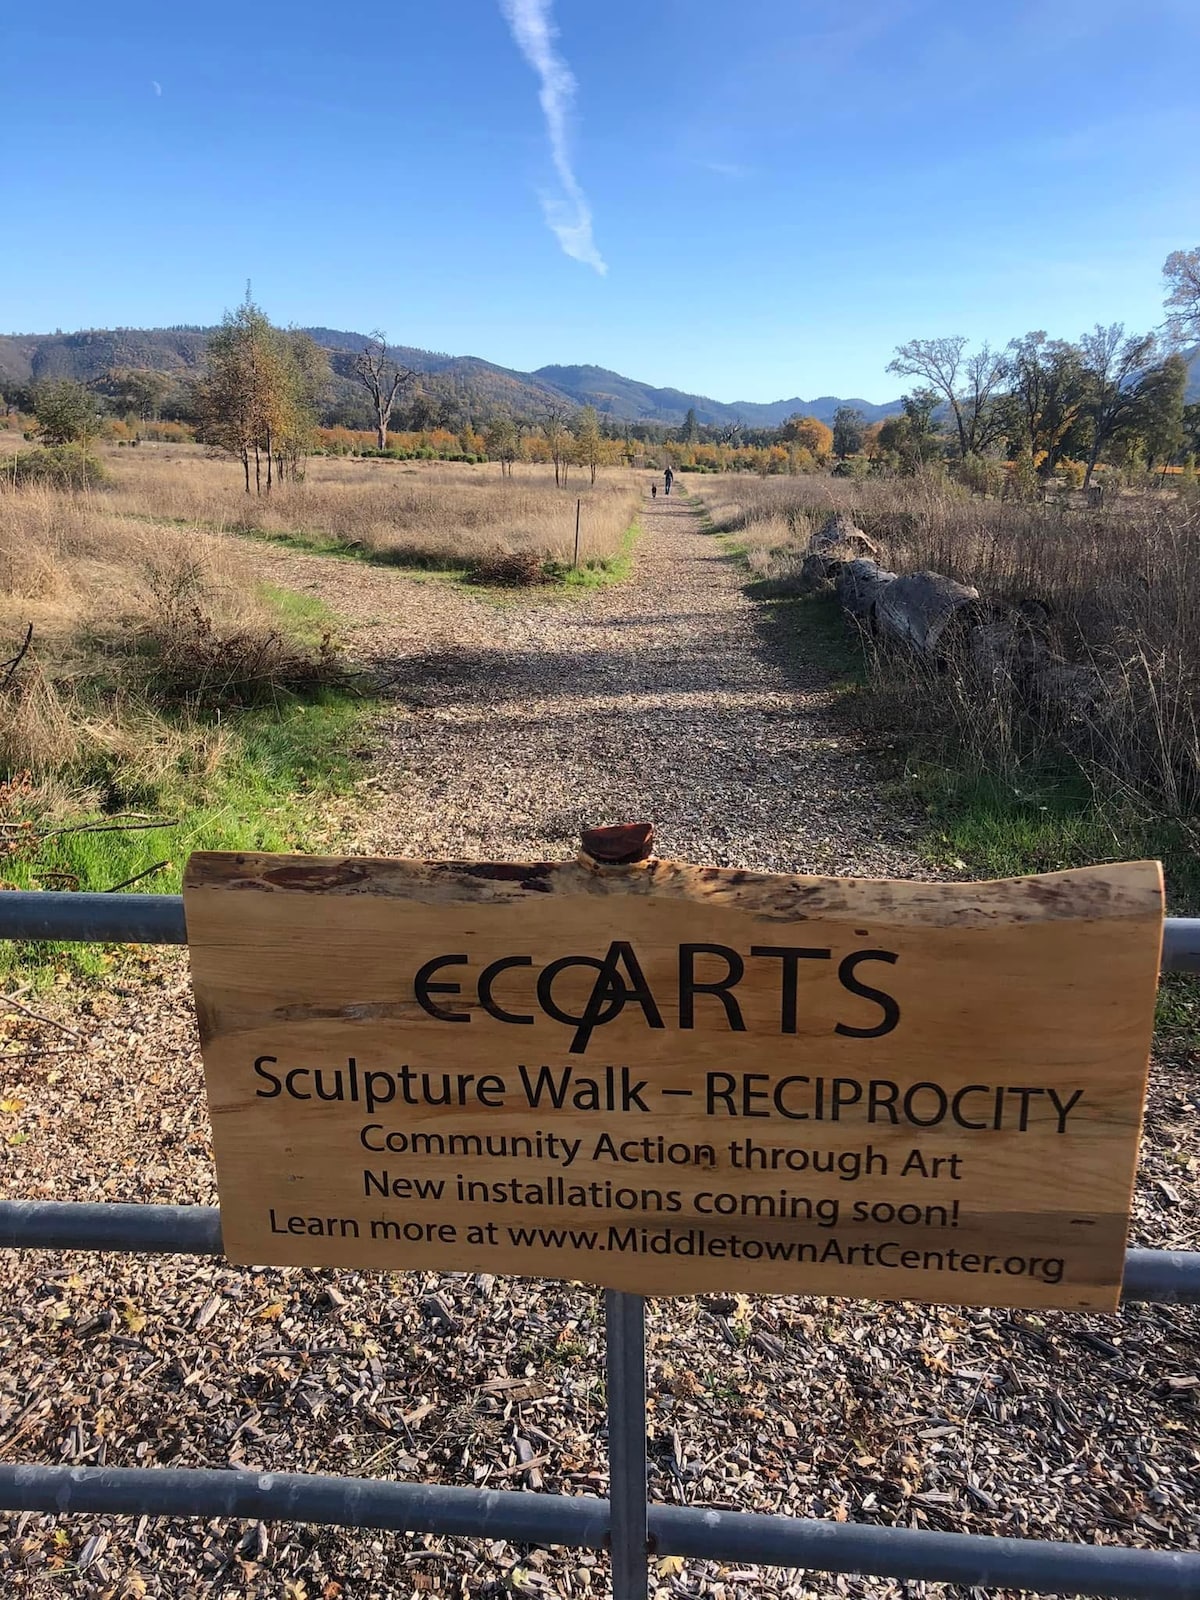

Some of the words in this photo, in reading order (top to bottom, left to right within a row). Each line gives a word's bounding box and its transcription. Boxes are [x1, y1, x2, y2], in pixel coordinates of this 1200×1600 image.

[254, 1056, 505, 1113] Sculpture
[518, 1065, 650, 1112] Walk
[706, 1071, 1084, 1133] RECIPROCITY
[360, 1124, 582, 1167] Community
[592, 1133, 716, 1167] Action
[729, 1138, 888, 1181] through
[901, 1149, 963, 1180] Art
[364, 1170, 445, 1200] New
[457, 1174, 681, 1212] installations
[693, 1188, 839, 1228] coming
[852, 1200, 960, 1227] soon!
[269, 1209, 360, 1238] Learn
[370, 1218, 457, 1243] more
[467, 1222, 499, 1246] at
[508, 1226, 1065, 1283] www.MiddletownArtCenter.org
